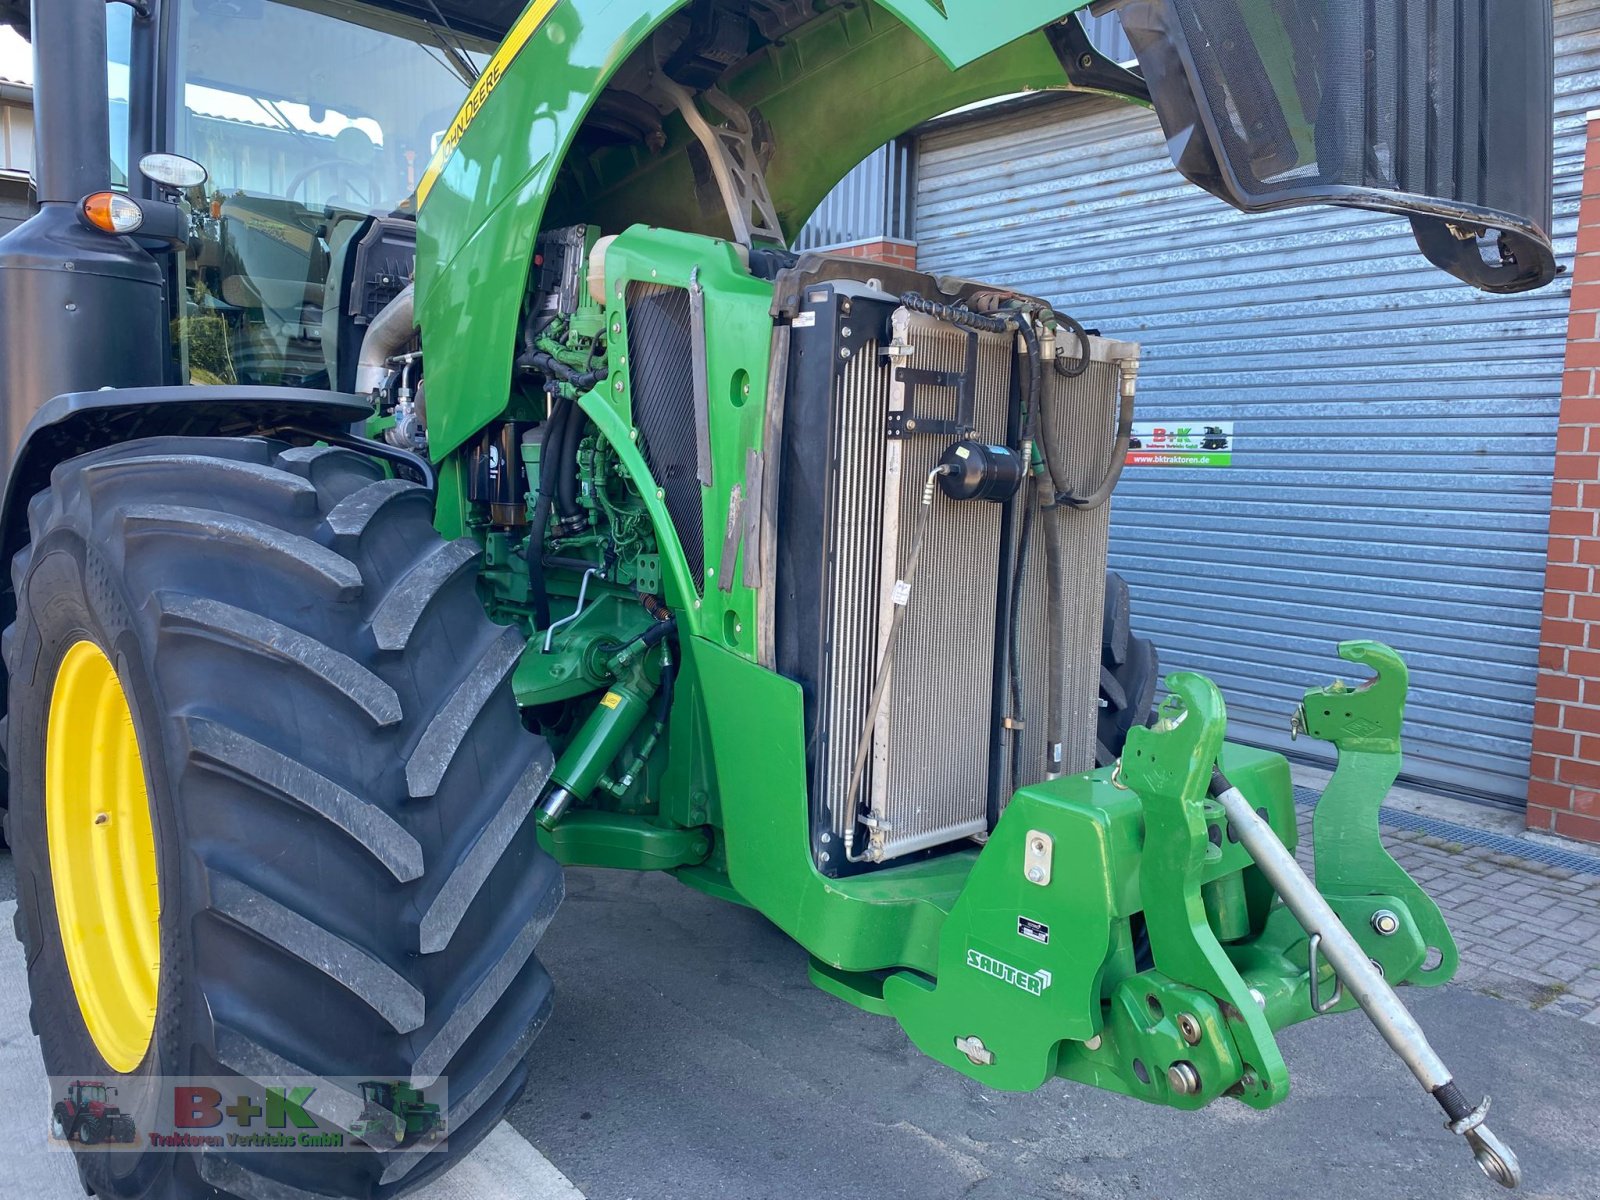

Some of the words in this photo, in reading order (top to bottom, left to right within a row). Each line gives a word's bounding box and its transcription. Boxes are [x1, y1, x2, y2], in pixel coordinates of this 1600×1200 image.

[464, 60, 501, 125] DEERE
[1153, 428, 1192, 442] B+K
[1133, 456, 1210, 464] www.bktraktoren.de
[967, 949, 1041, 997] SAUTER
